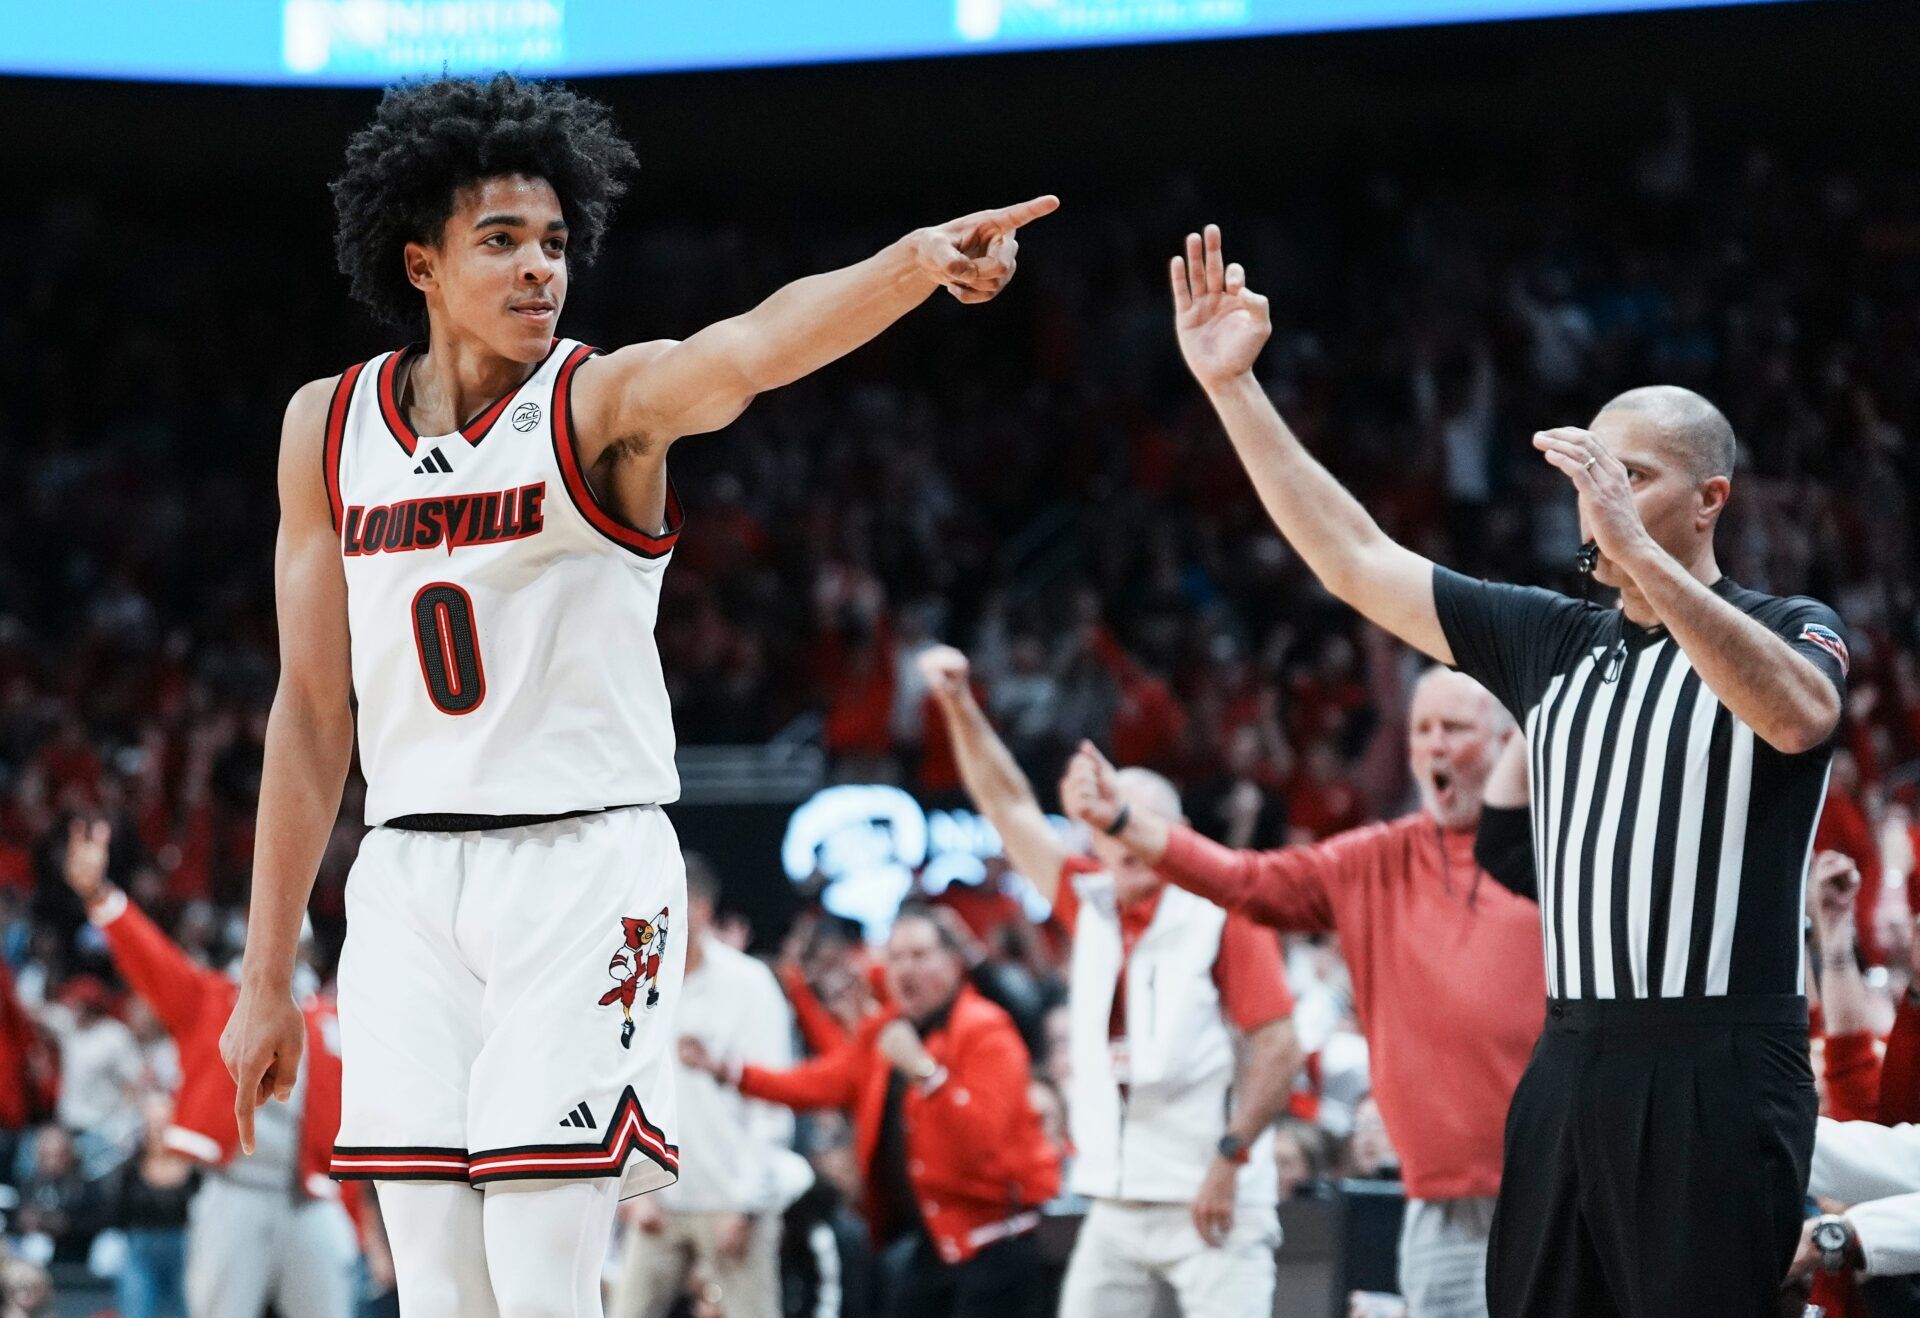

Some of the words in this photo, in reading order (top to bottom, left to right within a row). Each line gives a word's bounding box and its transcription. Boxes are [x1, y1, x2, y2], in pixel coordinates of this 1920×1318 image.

[515, 409, 540, 422] ACC
[343, 481, 547, 558] LOUISVILLE
[411, 581, 487, 716] 0
